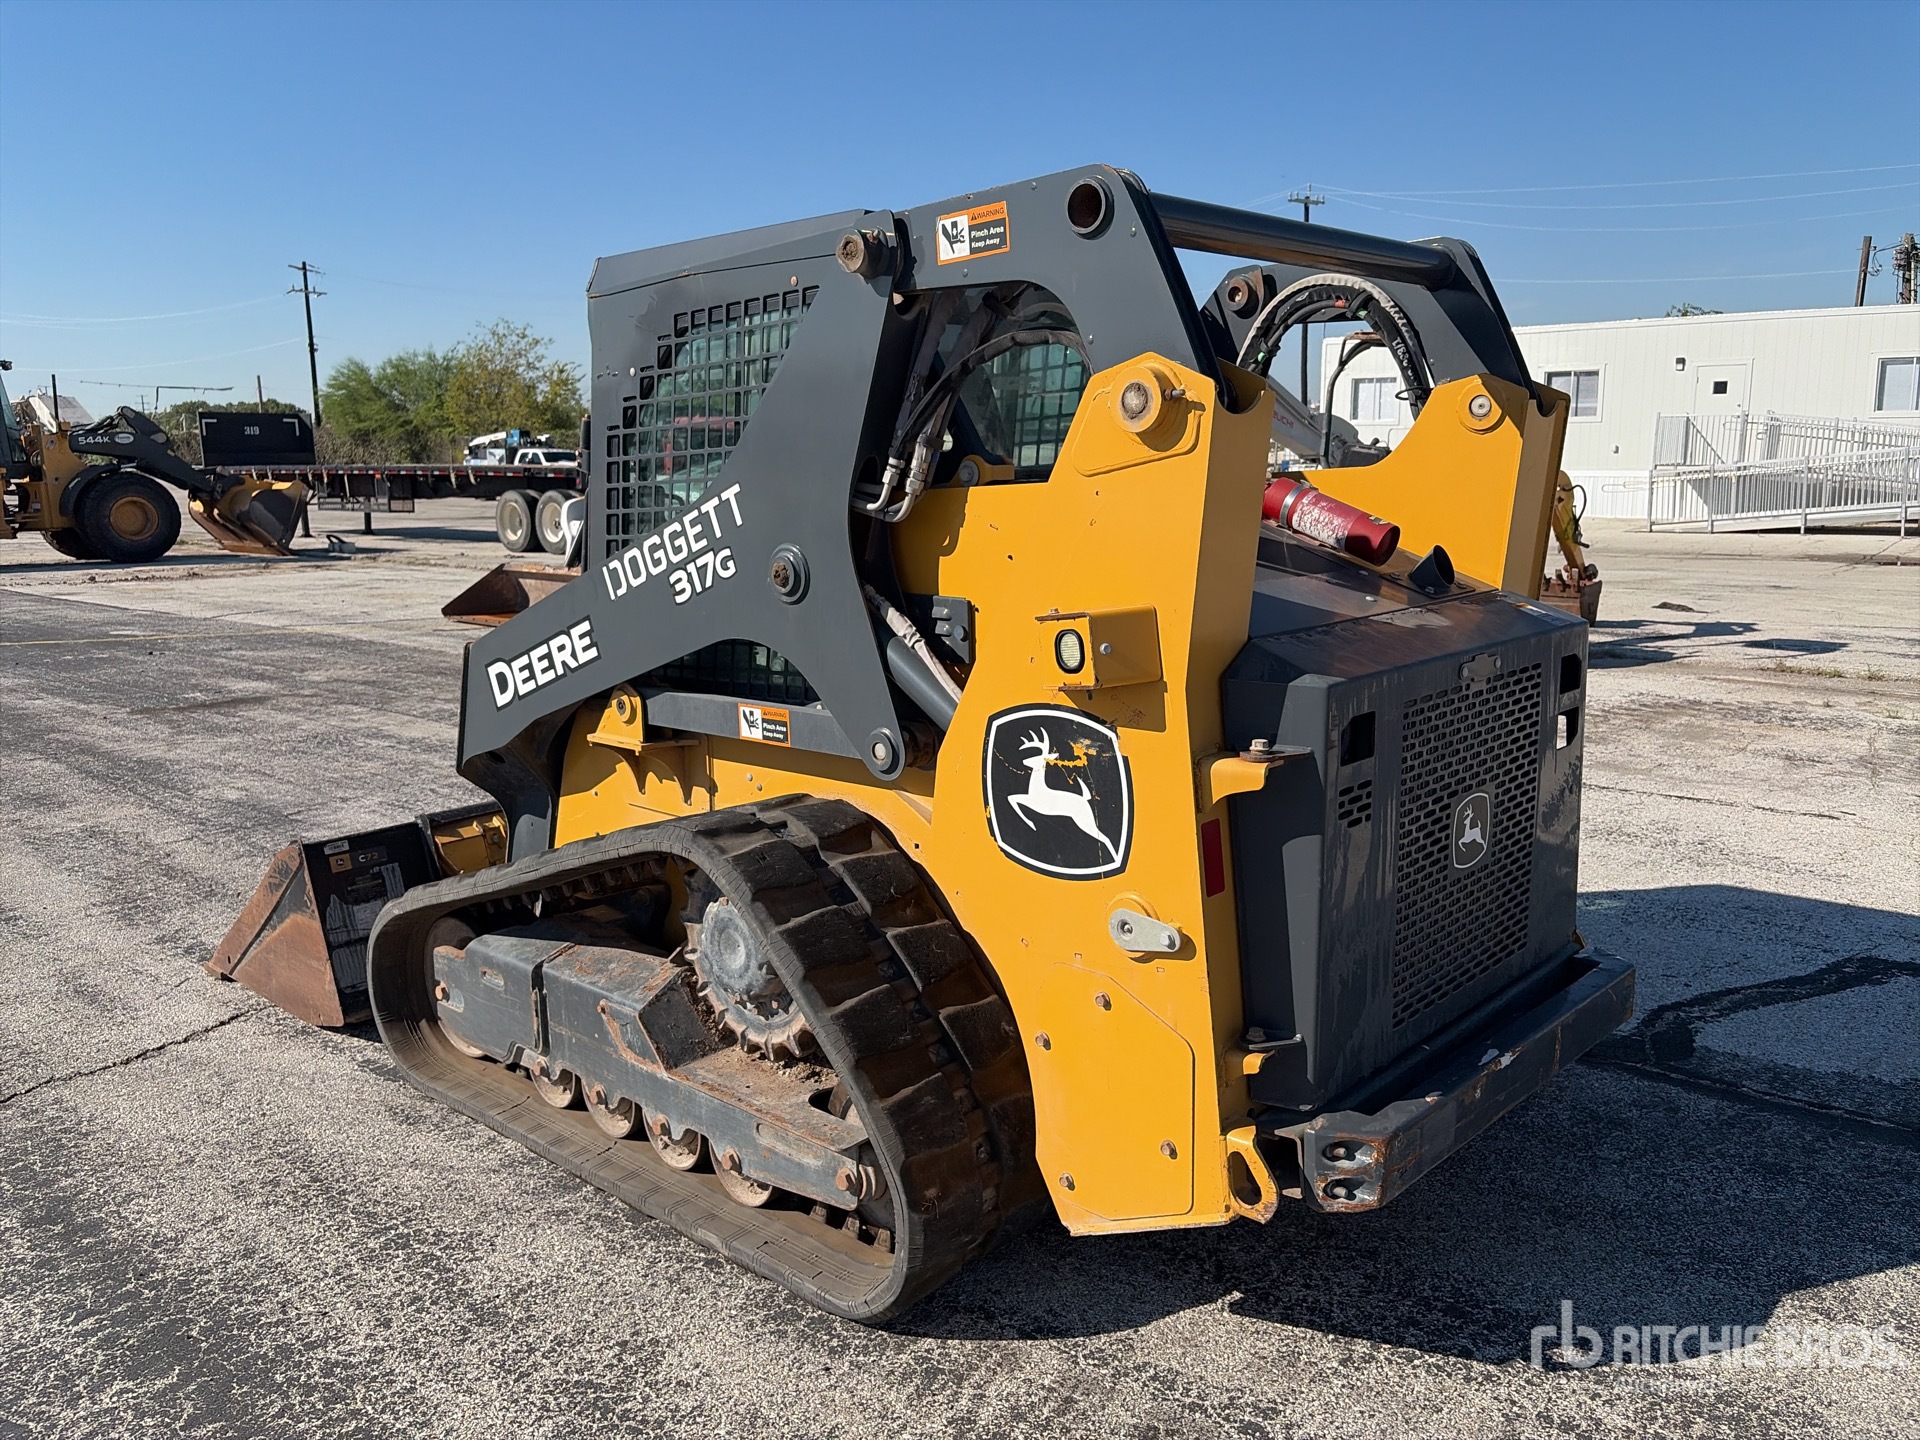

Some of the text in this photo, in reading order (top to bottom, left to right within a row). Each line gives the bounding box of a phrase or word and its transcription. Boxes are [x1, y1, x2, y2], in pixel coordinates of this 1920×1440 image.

[976, 207, 1005, 219] WARNING
[971, 226, 1004, 239] Pinch Area
[971, 237, 1000, 248] Keep Away
[244, 426, 260, 435] 319
[78, 435, 111, 445] 544K
[602, 483, 743, 600] DOGGETT
[668, 548, 737, 604] 317G
[486, 619, 599, 708] DEERE
[358, 852, 379, 862] C72
